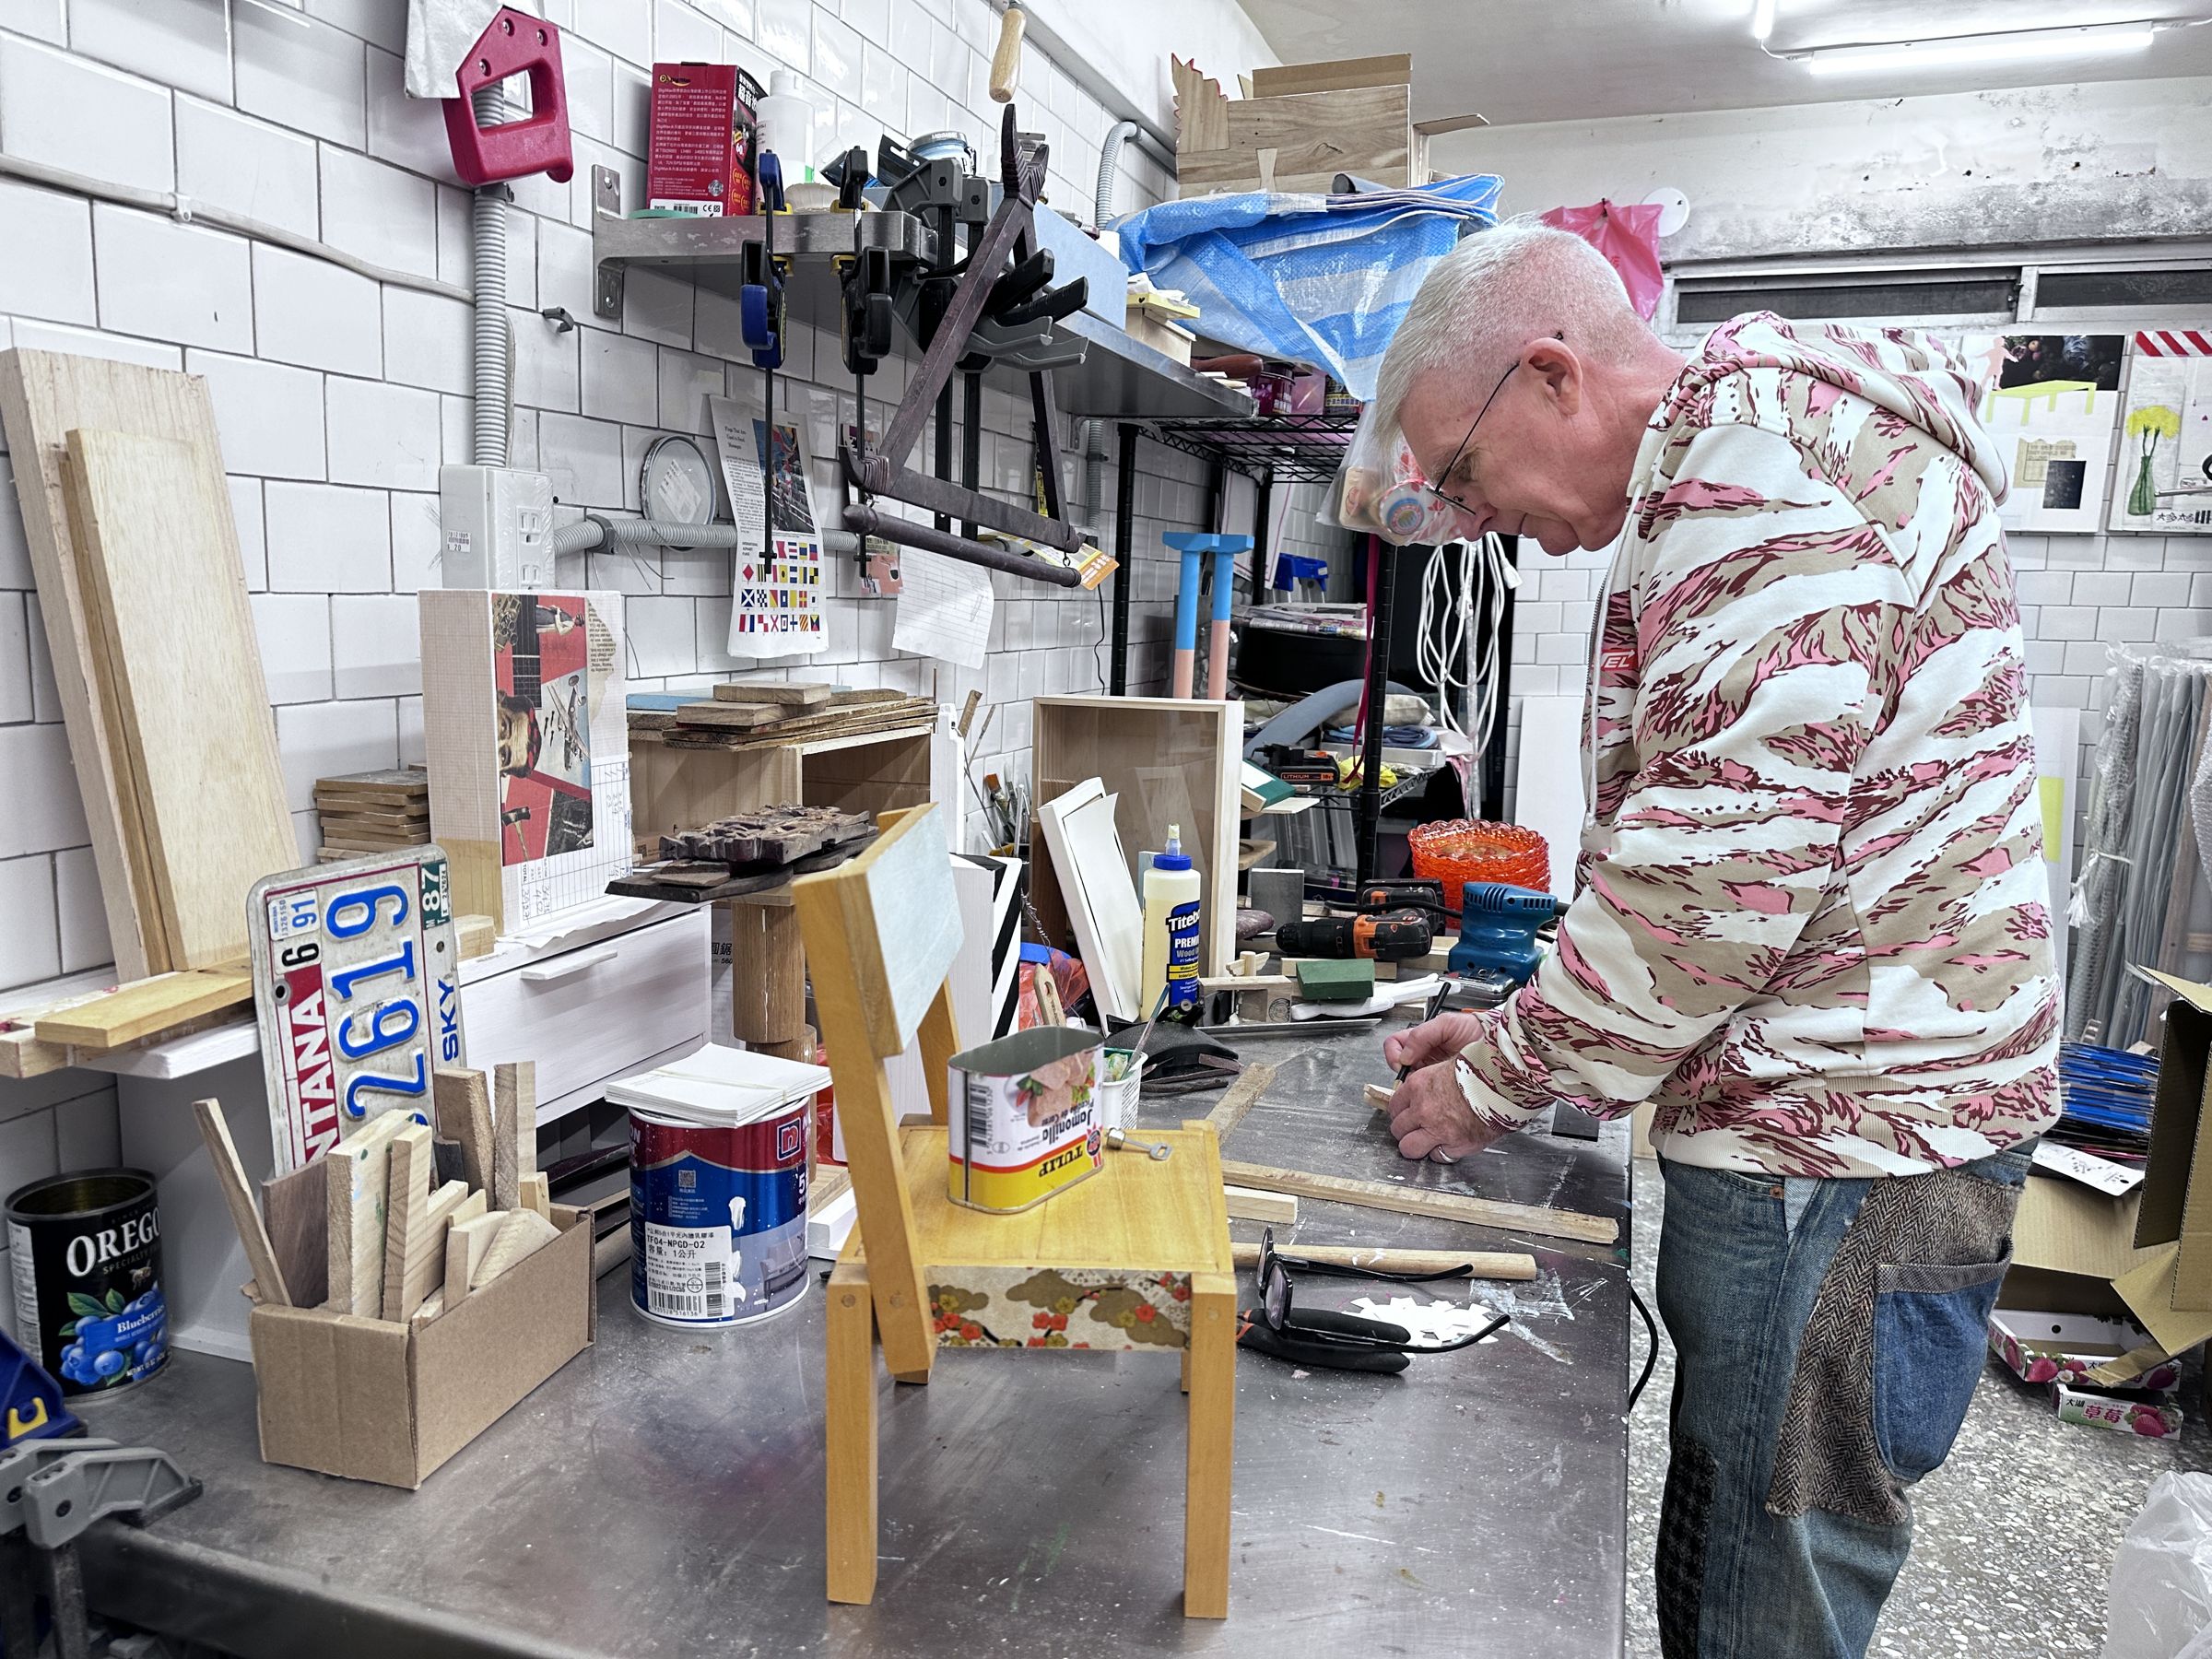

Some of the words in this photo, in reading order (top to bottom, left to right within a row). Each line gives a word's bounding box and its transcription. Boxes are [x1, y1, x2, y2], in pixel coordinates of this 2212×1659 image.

[421, 864, 441, 912] 87
[290, 896, 318, 929] 91
[281, 942, 320, 968] 6
[325, 885, 429, 1126] 2619
[437, 978, 460, 1063] SKY
[1042, 1109, 1093, 1145] Jamonilla
[1038, 1145, 1083, 1178] TULIP
[647, 1234, 705, 1249] TF04-NPGD-02
[673, 1249, 697, 1260] 1公升
[2083, 1405, 2124, 1424] 草莓
